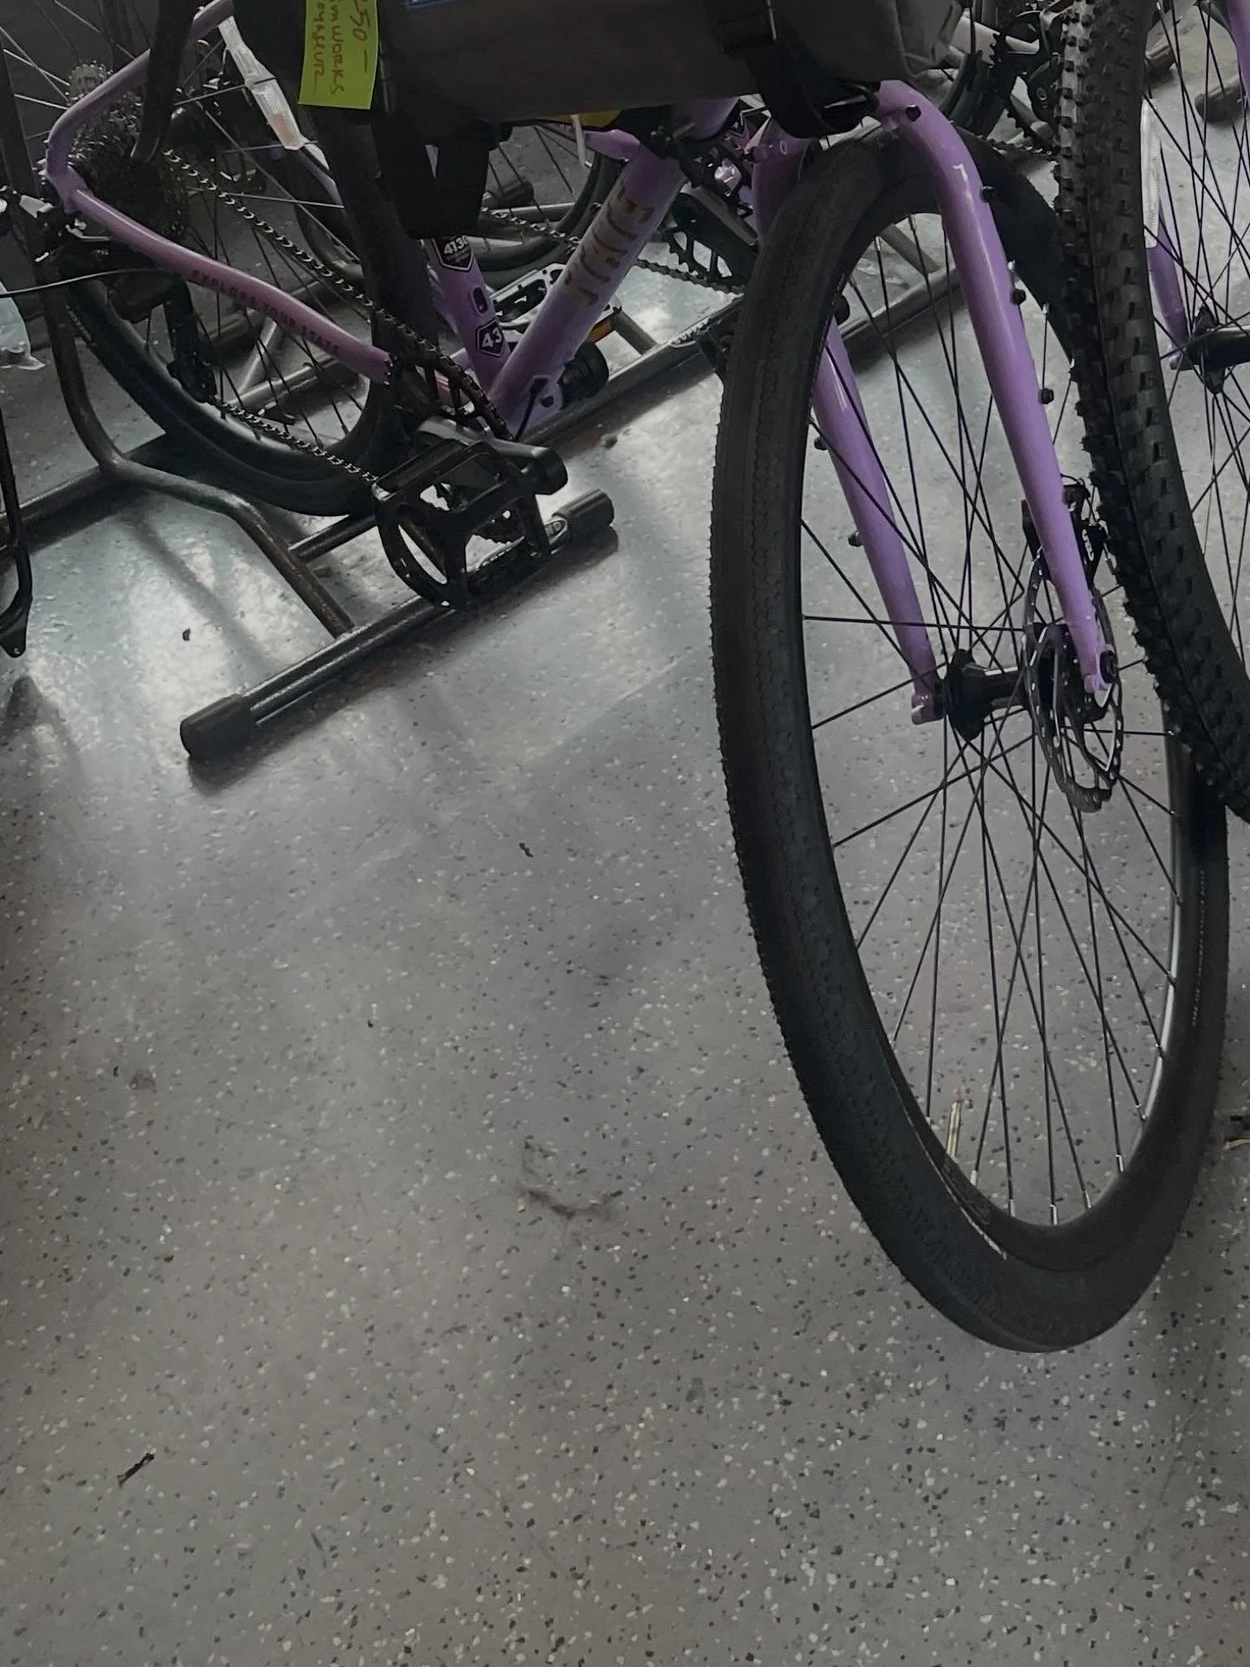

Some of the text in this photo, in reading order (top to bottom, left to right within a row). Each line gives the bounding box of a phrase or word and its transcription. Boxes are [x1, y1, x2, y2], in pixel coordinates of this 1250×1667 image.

[191, 269, 342, 354] EXPLORE YOUR STATE
